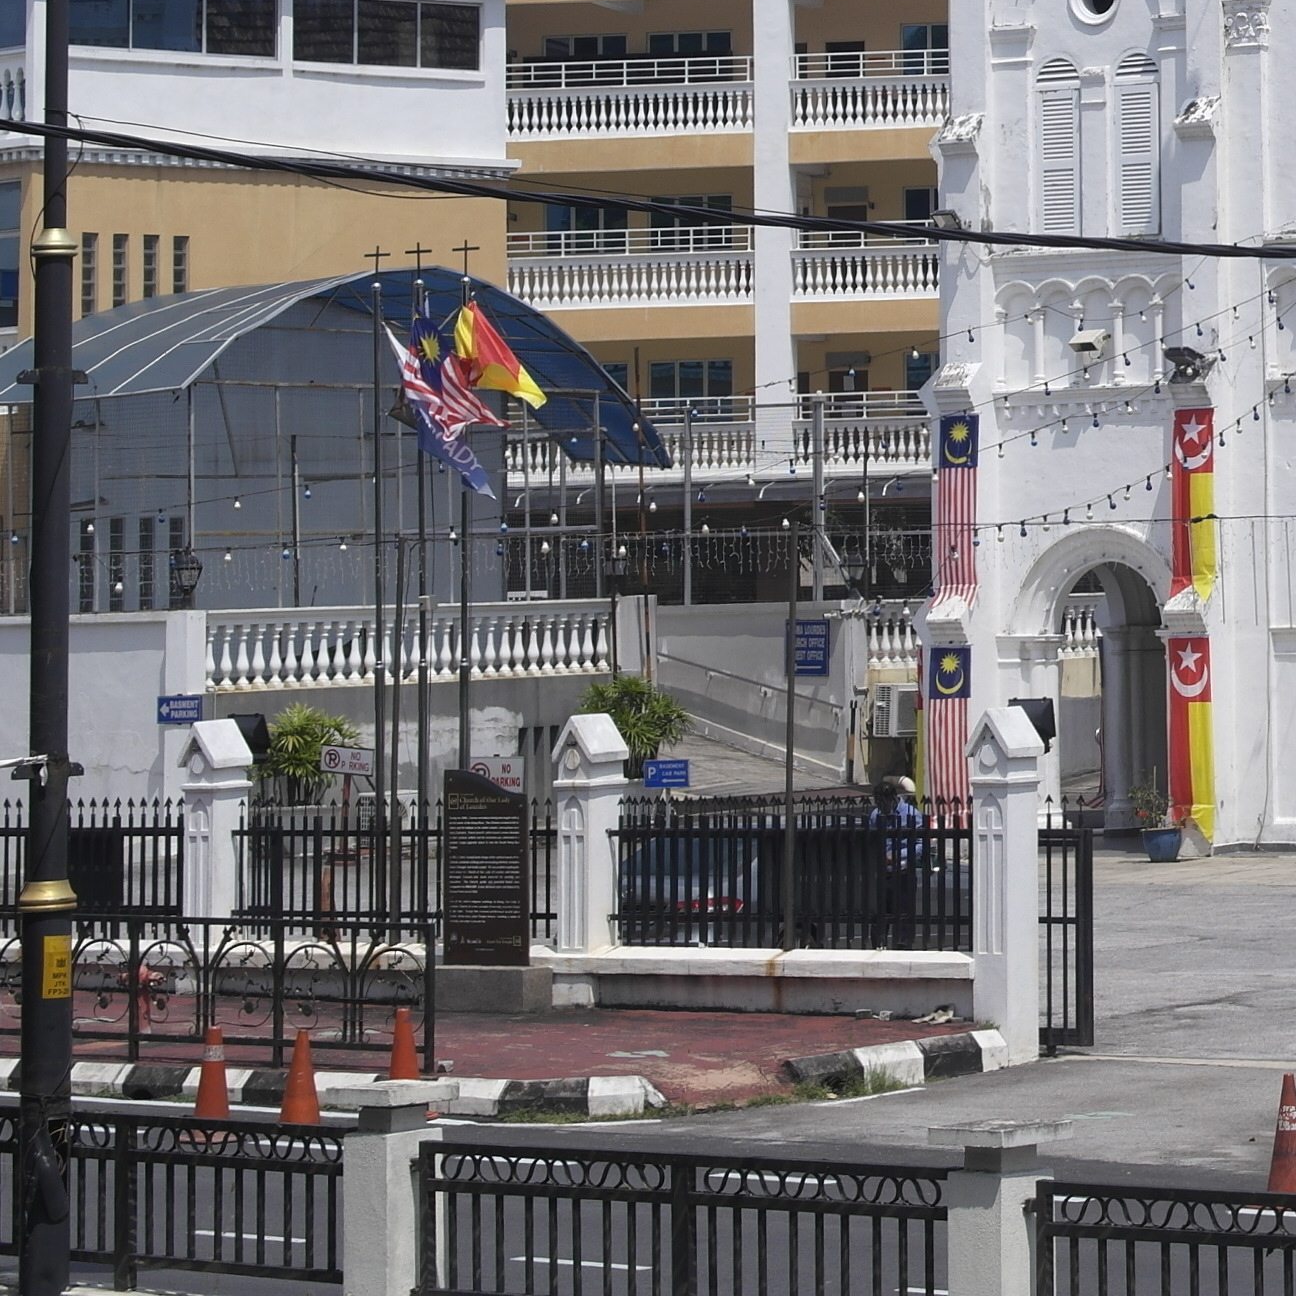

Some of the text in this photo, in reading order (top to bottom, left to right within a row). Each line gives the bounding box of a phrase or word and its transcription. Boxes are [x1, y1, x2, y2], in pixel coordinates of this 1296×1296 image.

[351, 752, 361, 761] NO
[341, 761, 369, 772] PRKING
[502, 764, 511, 774] NO
